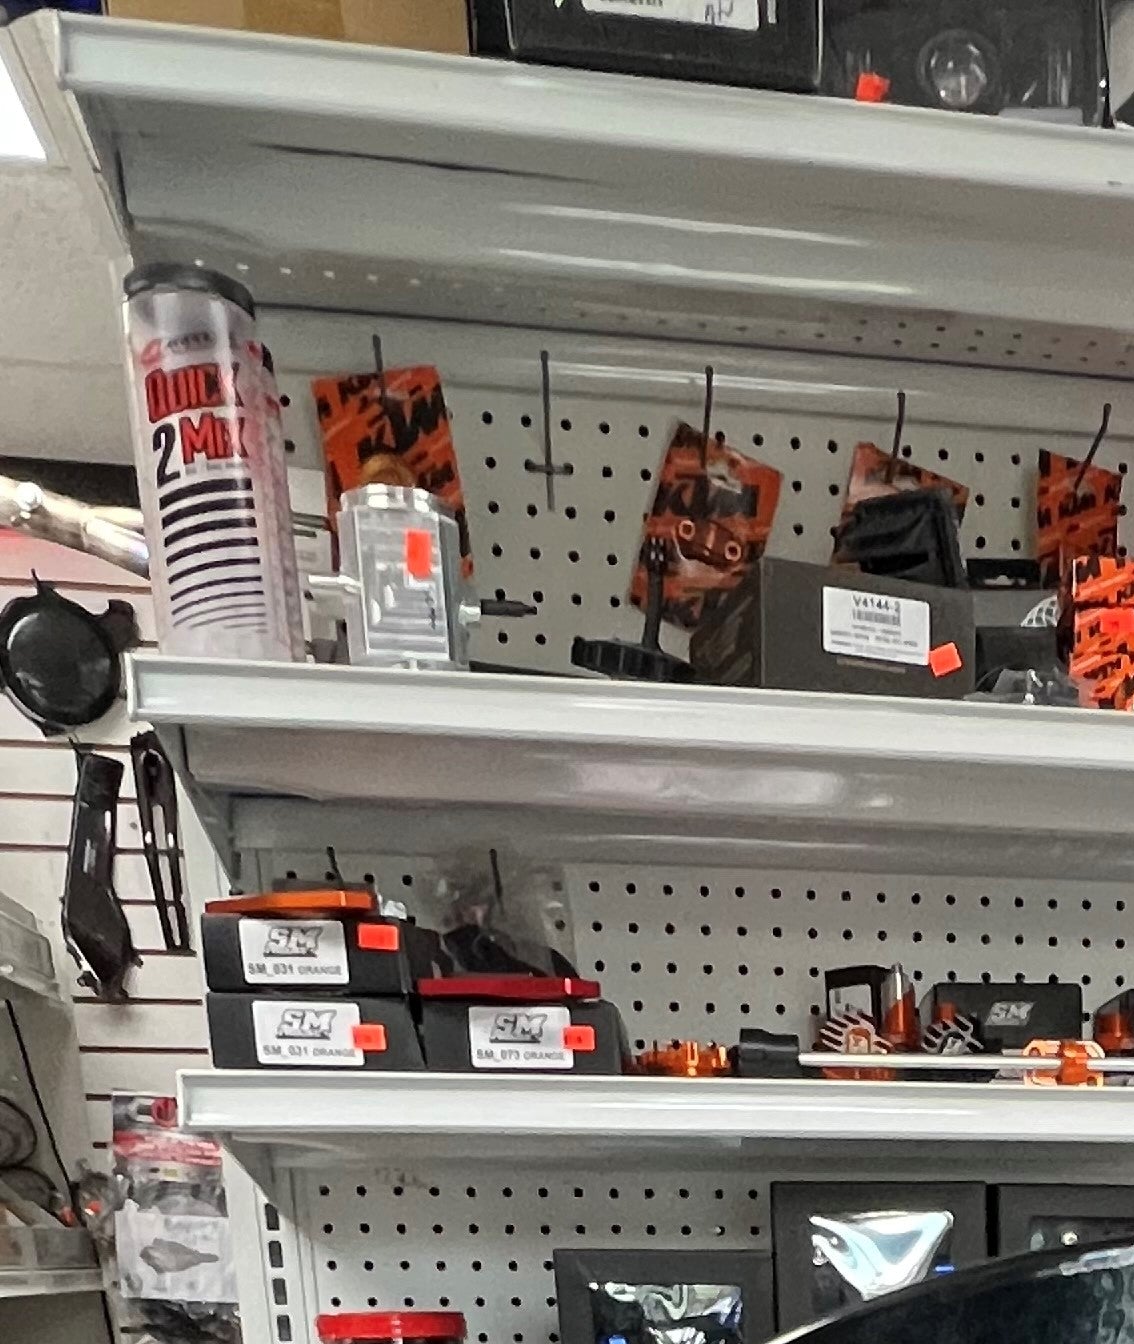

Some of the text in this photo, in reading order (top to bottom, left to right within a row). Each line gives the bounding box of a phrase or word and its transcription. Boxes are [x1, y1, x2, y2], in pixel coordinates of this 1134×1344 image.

[145, 361, 244, 423] QUICK
[152, 412, 249, 489] 2 MIX
